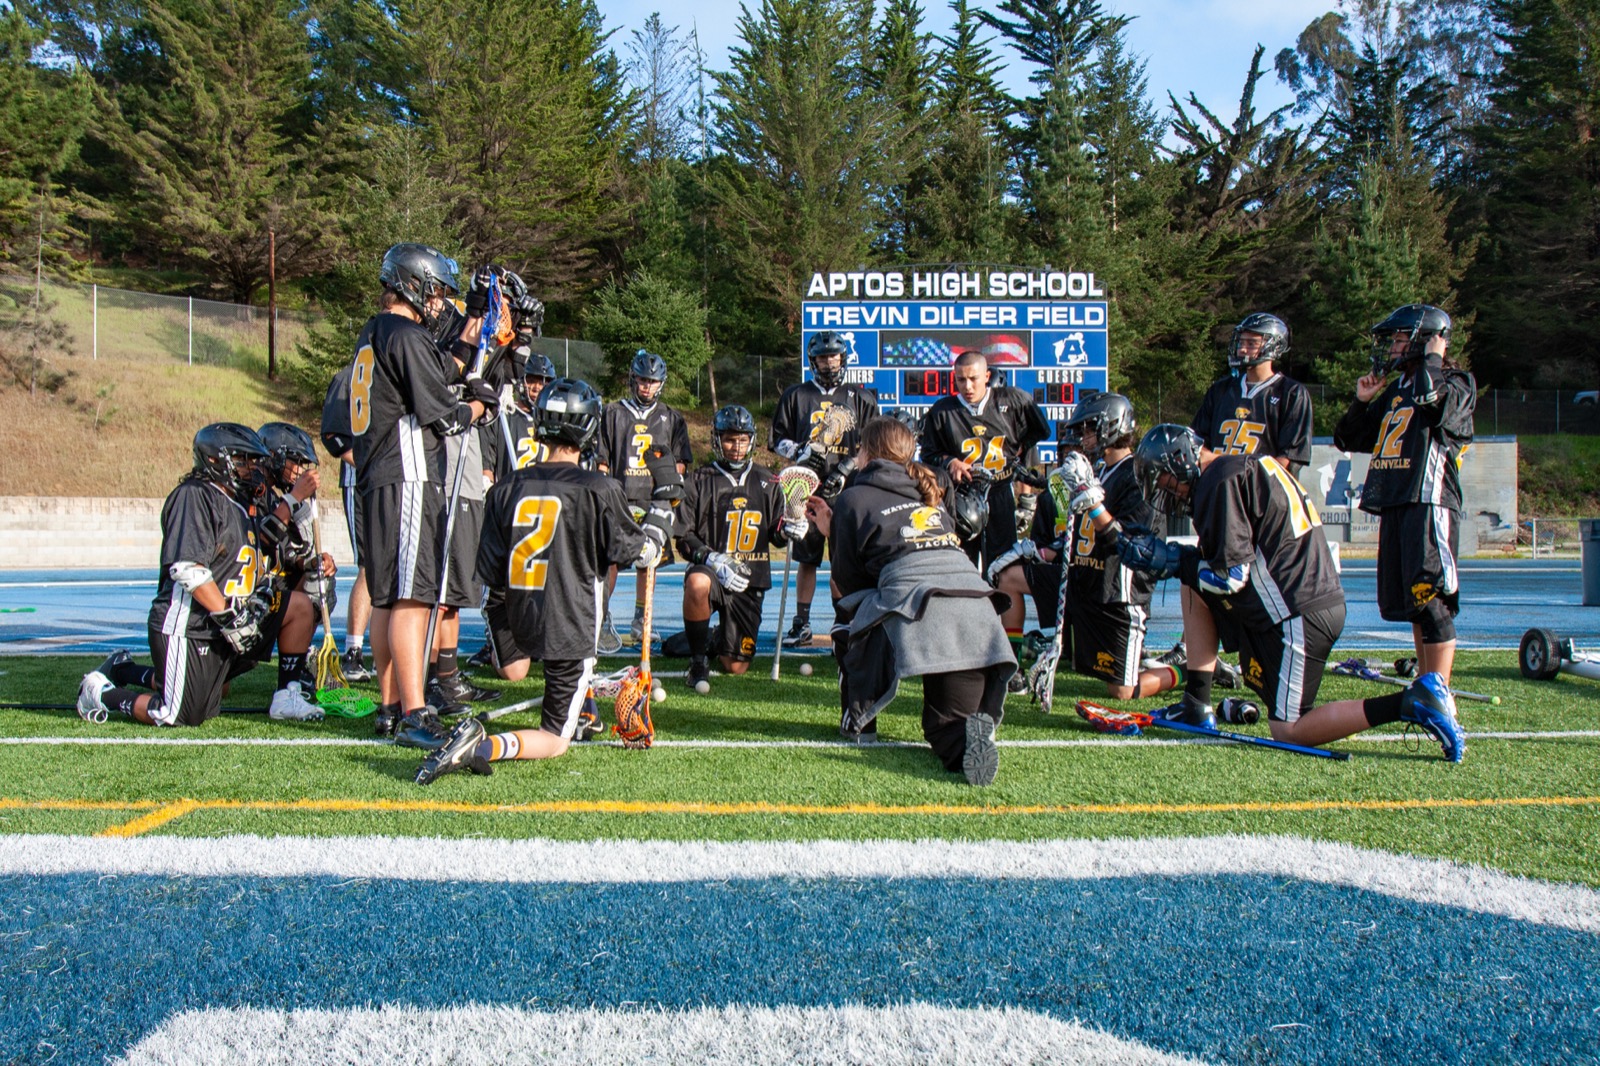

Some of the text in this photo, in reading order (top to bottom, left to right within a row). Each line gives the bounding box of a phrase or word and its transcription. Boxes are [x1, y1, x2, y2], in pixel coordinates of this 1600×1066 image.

[807, 272, 1103, 297] APTOS HIGH SCHOOL
[805, 306, 1104, 325] TREVIN DILFER FIELD
[351, 345, 374, 437] 8
[1037, 369, 1083, 383] GUESTS
[1061, 383, 1074, 404] 0
[1046, 407, 1065, 420] YDS
[1213, 419, 1266, 456] 35
[961, 435, 1007, 474] 24
[508, 495, 562, 591] 2
[725, 510, 762, 554] 16
